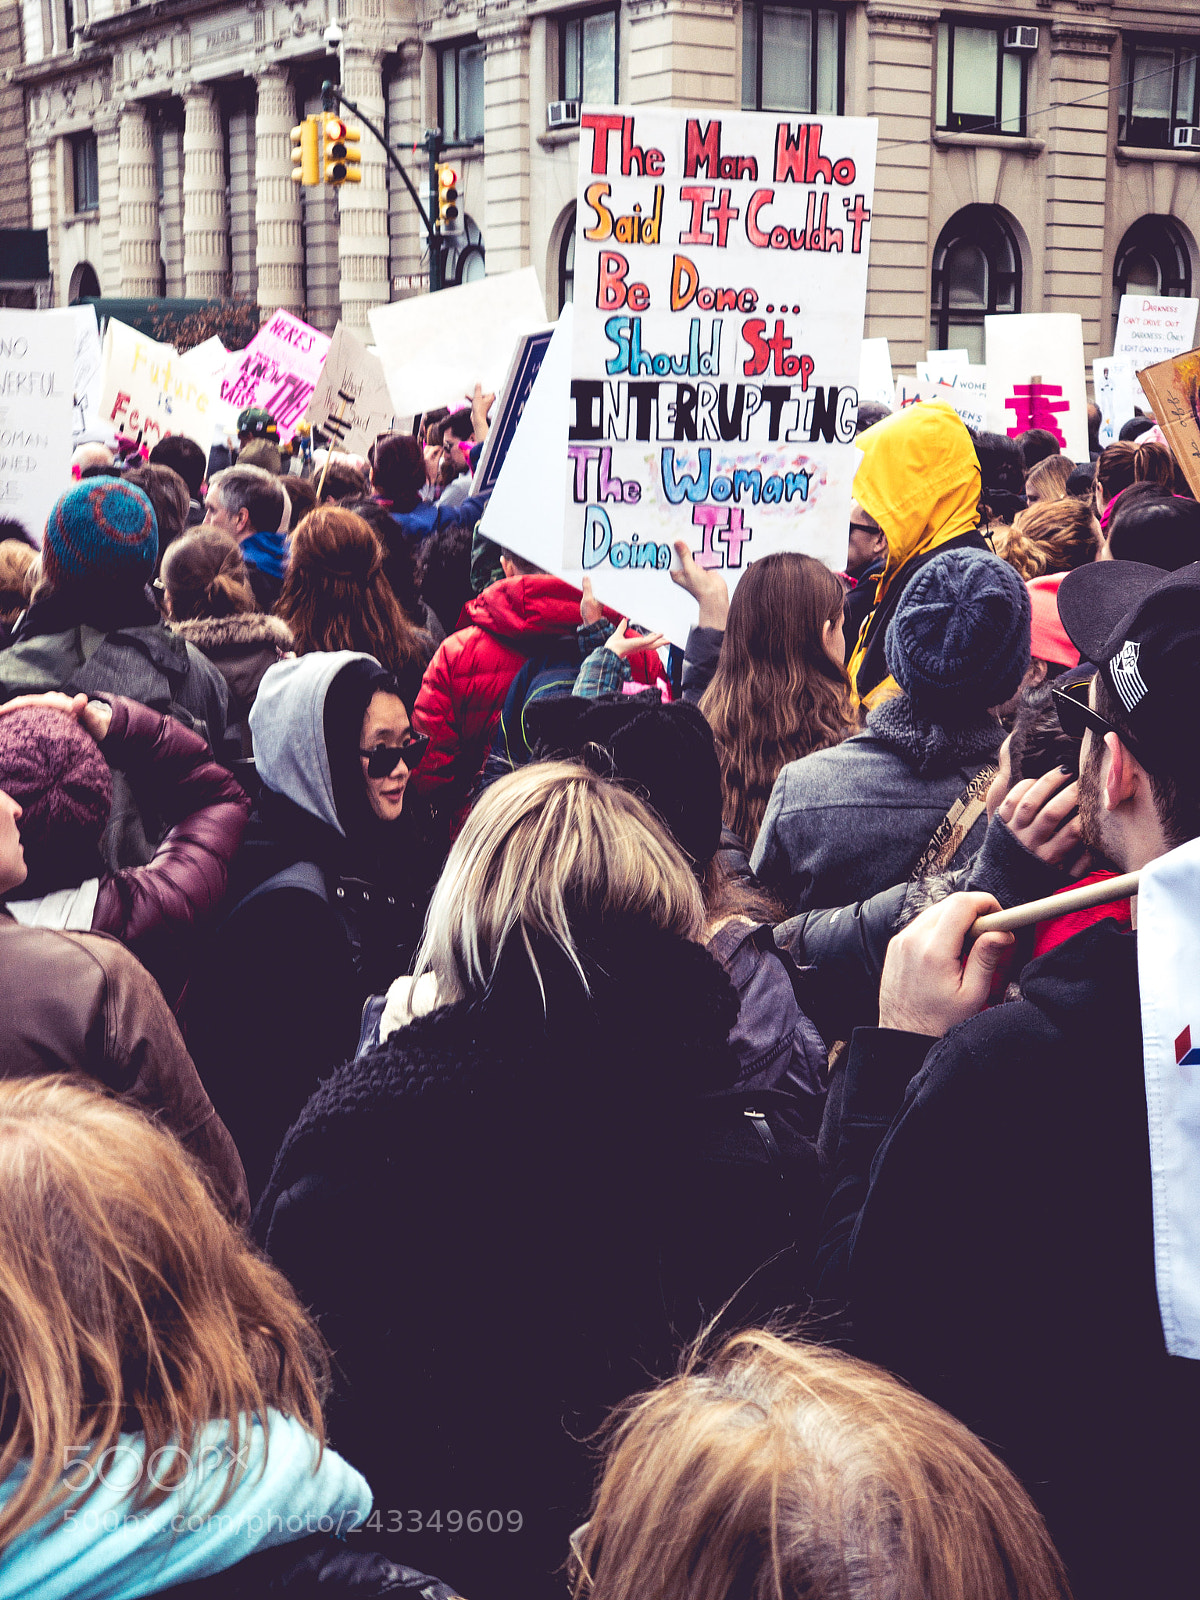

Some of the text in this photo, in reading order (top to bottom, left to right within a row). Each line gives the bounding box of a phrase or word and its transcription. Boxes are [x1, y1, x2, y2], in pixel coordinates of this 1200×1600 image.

[581, 114, 856, 186] The Man Who
[583, 181, 871, 254] Said It Couldn't
[596, 250, 801, 314] Be Done...
[1142, 300, 1178, 313] DARKNESS
[131, 342, 209, 414] Future
[604, 315, 815, 392] Should Stop
[959, 381, 987, 390] WOME
[0, 430, 49, 450] OMAN
[568, 379, 860, 444] INTERRUPTING
[567, 445, 813, 505] The Woman
[582, 503, 672, 571] Doing
